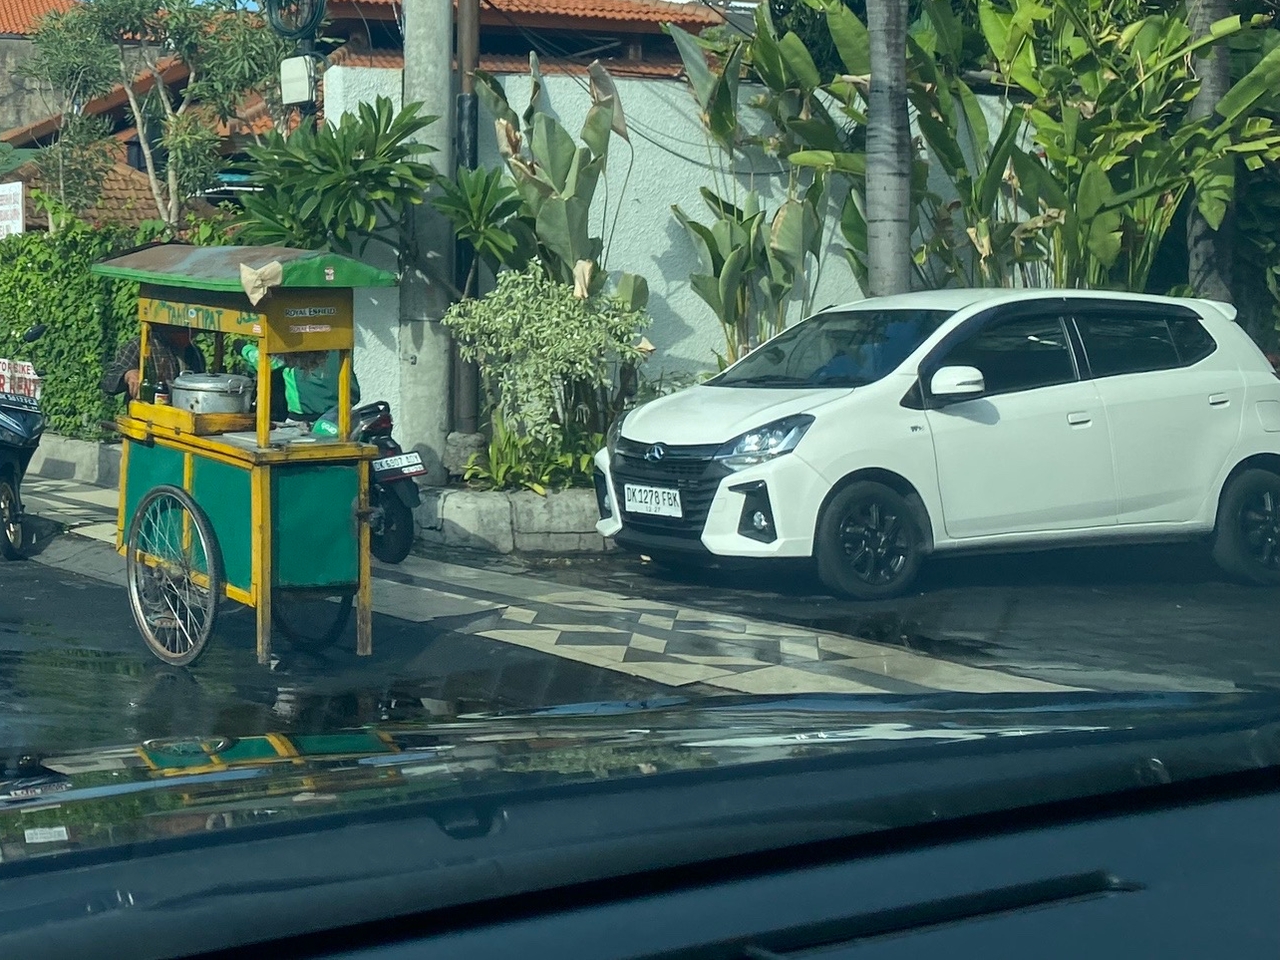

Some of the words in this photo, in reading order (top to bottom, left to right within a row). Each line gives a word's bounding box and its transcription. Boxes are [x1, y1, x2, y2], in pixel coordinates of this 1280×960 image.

[285, 309, 307, 317] ROYAL
[308, 307, 336, 316] ENFIELD
[9, 375, 41, 398] RENT
[373, 460, 385, 470] DK
[627, 487, 637, 503] DK
[638, 489, 660, 505] 1278
[662, 491, 679, 507] FBK
